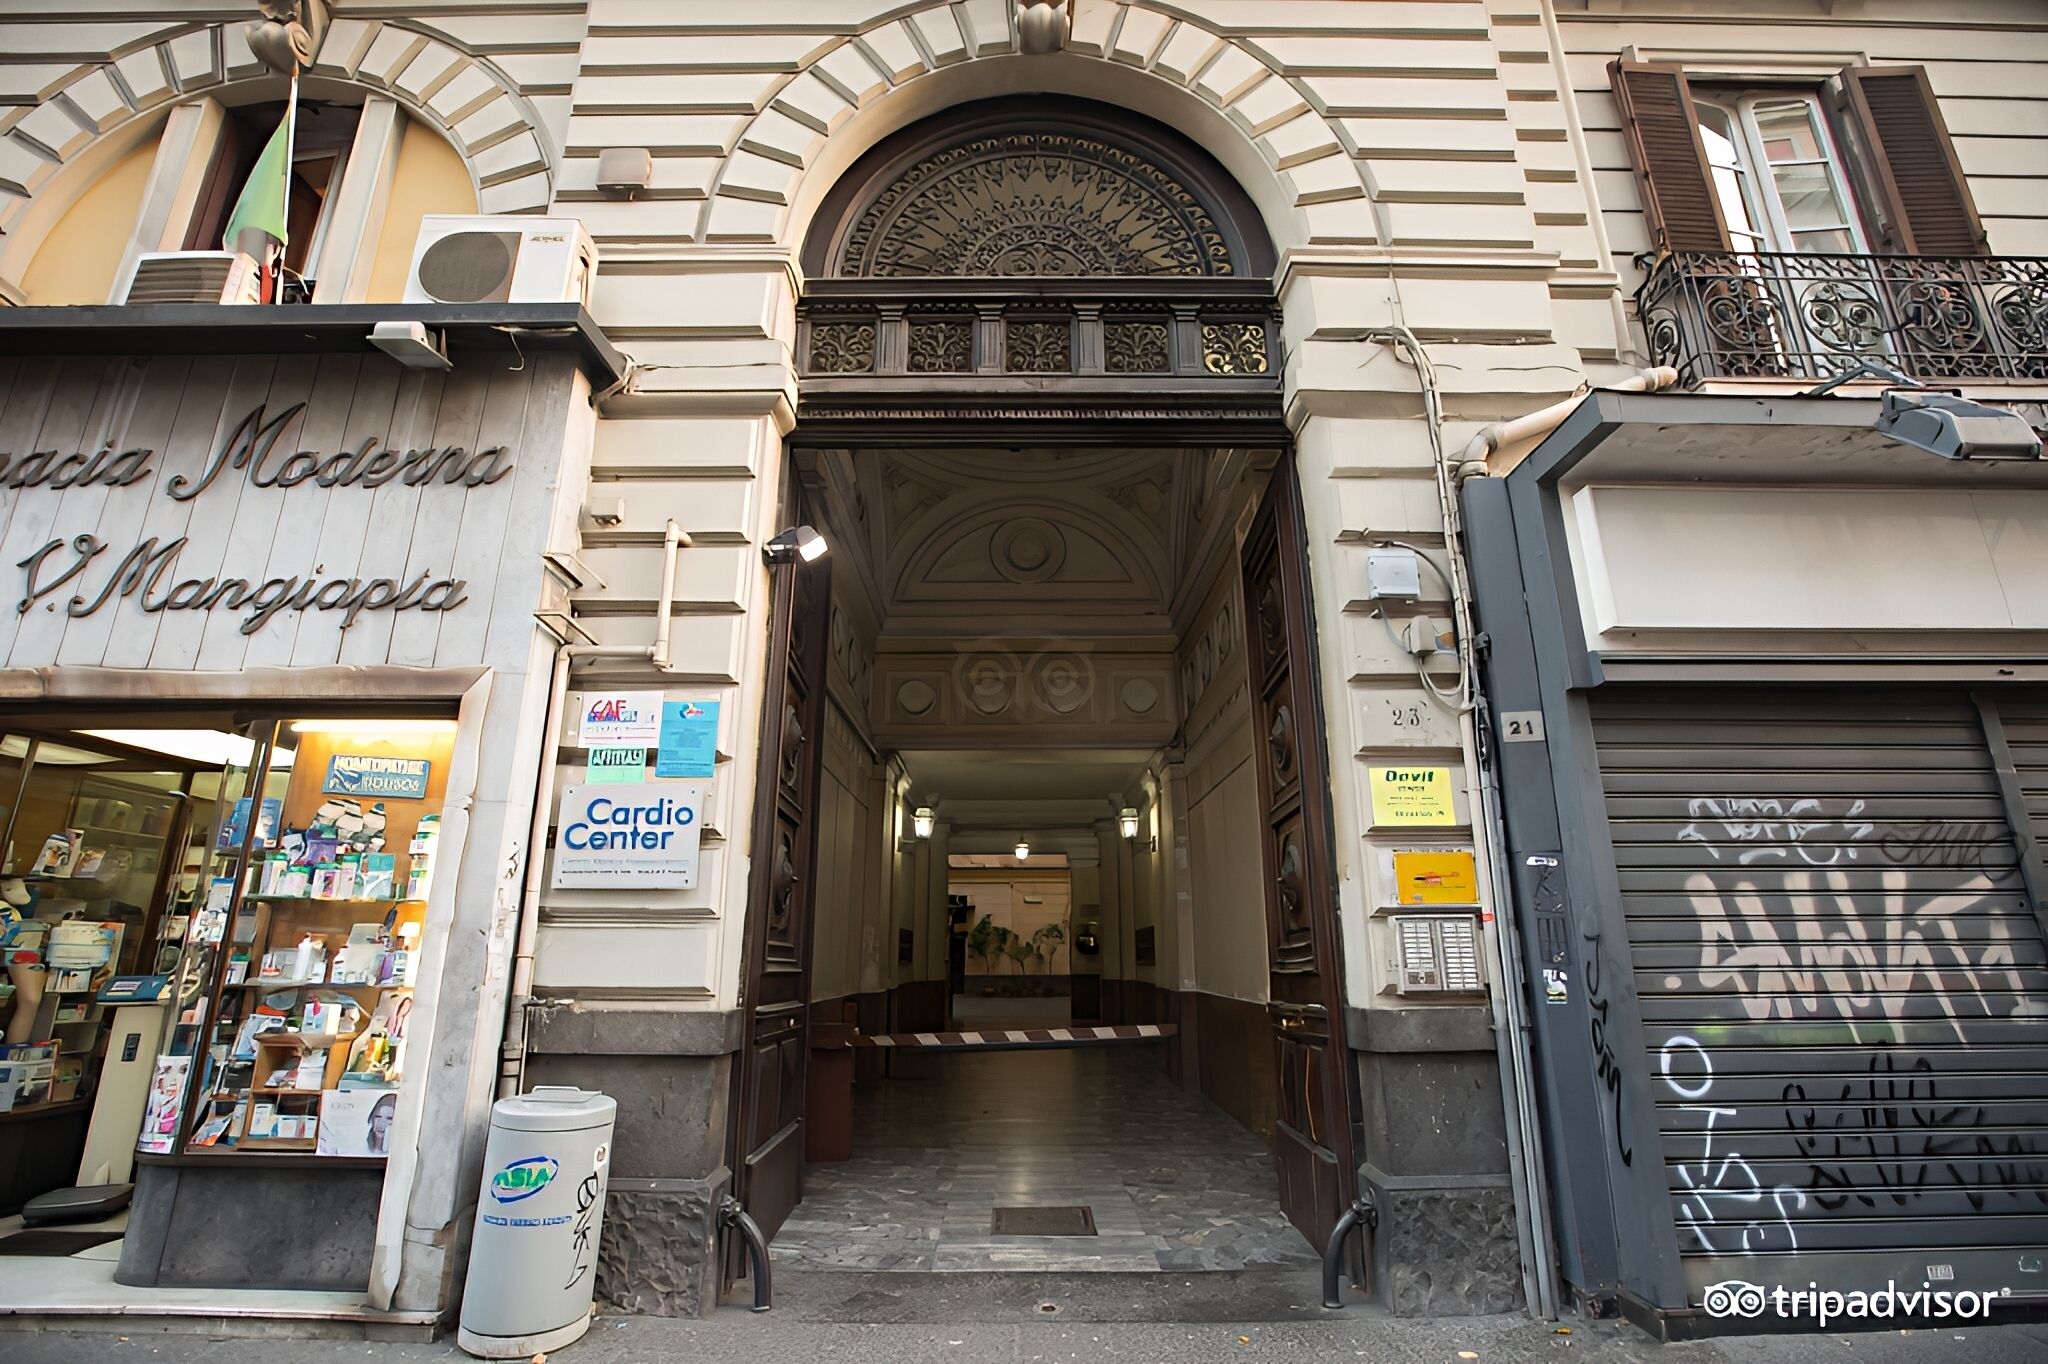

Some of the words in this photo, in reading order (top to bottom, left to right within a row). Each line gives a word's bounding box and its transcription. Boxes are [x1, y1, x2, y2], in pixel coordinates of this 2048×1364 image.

[167, 401, 514, 500] Moderna
[68, 536, 469, 636] Mangiapia
[590, 699, 627, 722] CAF
[1392, 708, 1420, 726] 23
[1508, 720, 1534, 735] 21
[586, 798, 694, 826] Cardio
[564, 822, 674, 850] Center
[494, 1167, 550, 1188] ASIA
